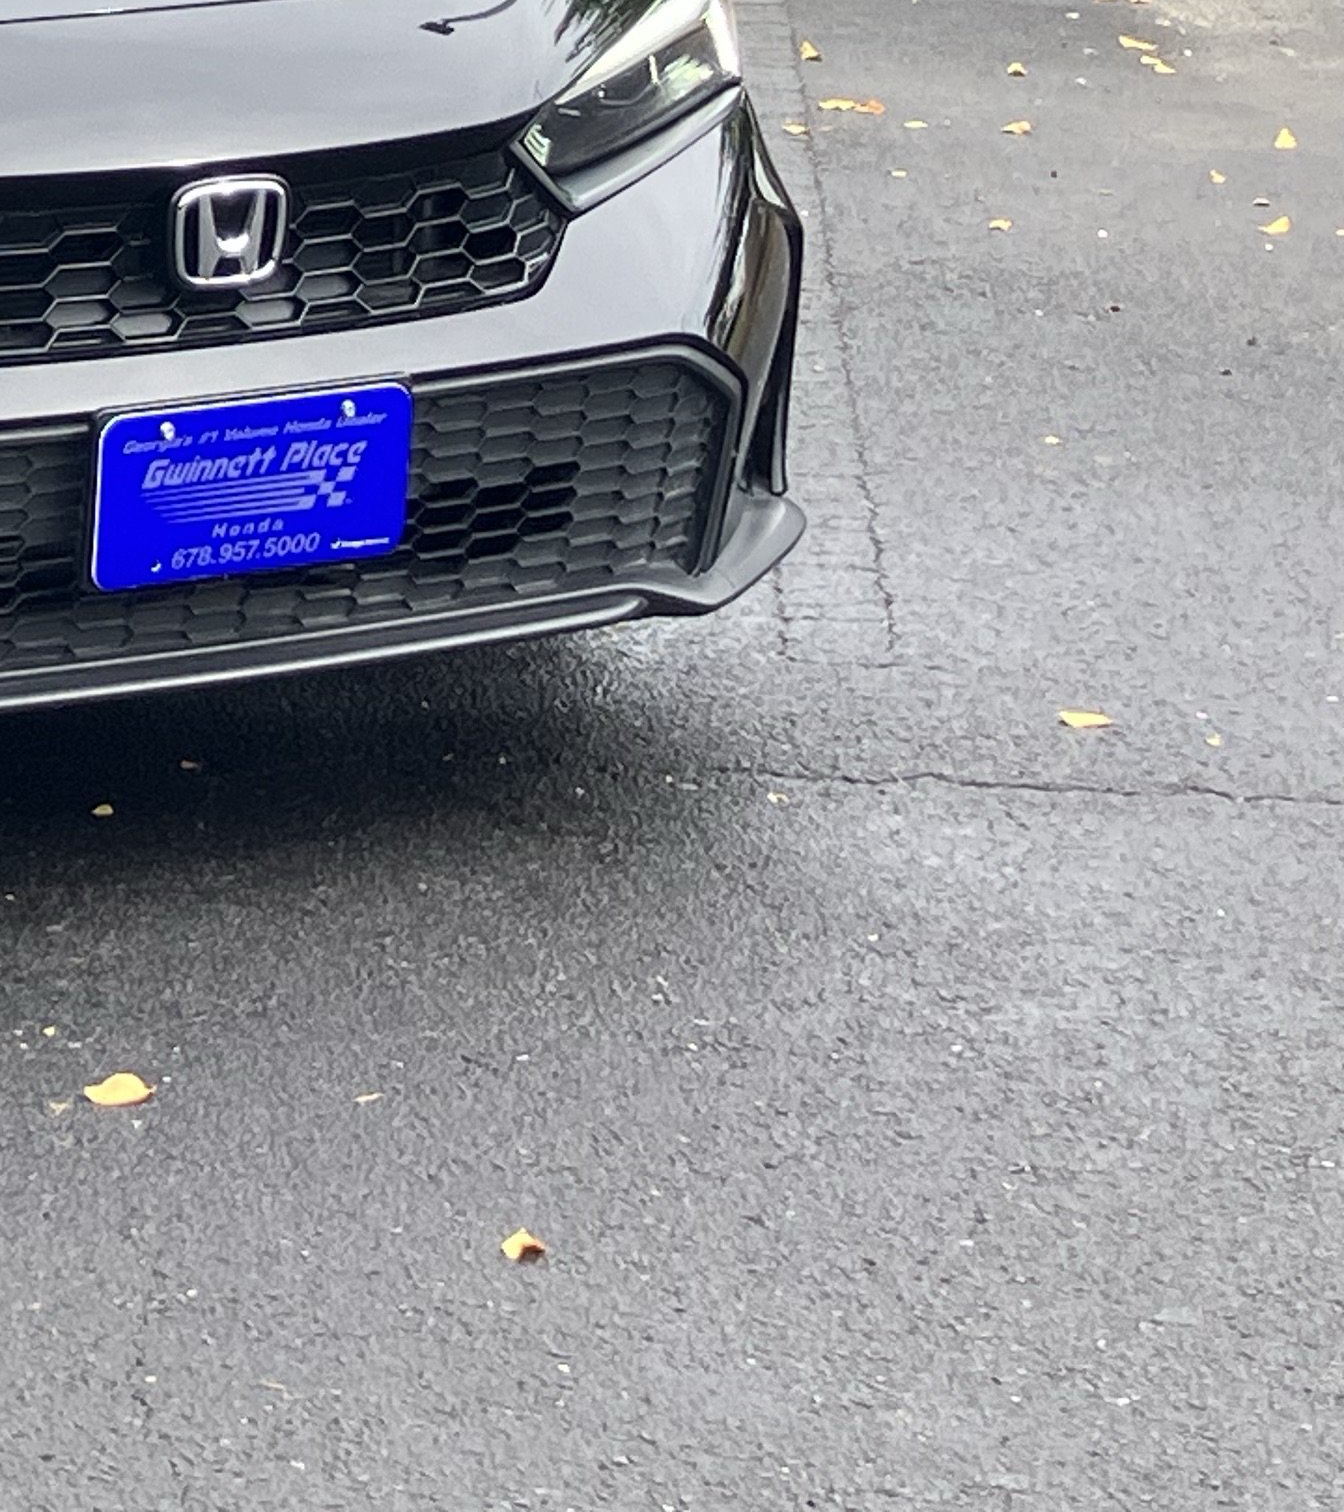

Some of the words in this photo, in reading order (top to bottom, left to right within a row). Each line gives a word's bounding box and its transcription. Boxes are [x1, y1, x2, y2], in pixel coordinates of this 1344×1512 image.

[283, 417, 332, 435] Honda
[141, 444, 277, 490] Gwinnett
[279, 439, 368, 472] Place
[211, 517, 284, 539] Honda
[171, 531, 321, 571] 678.957.5000
